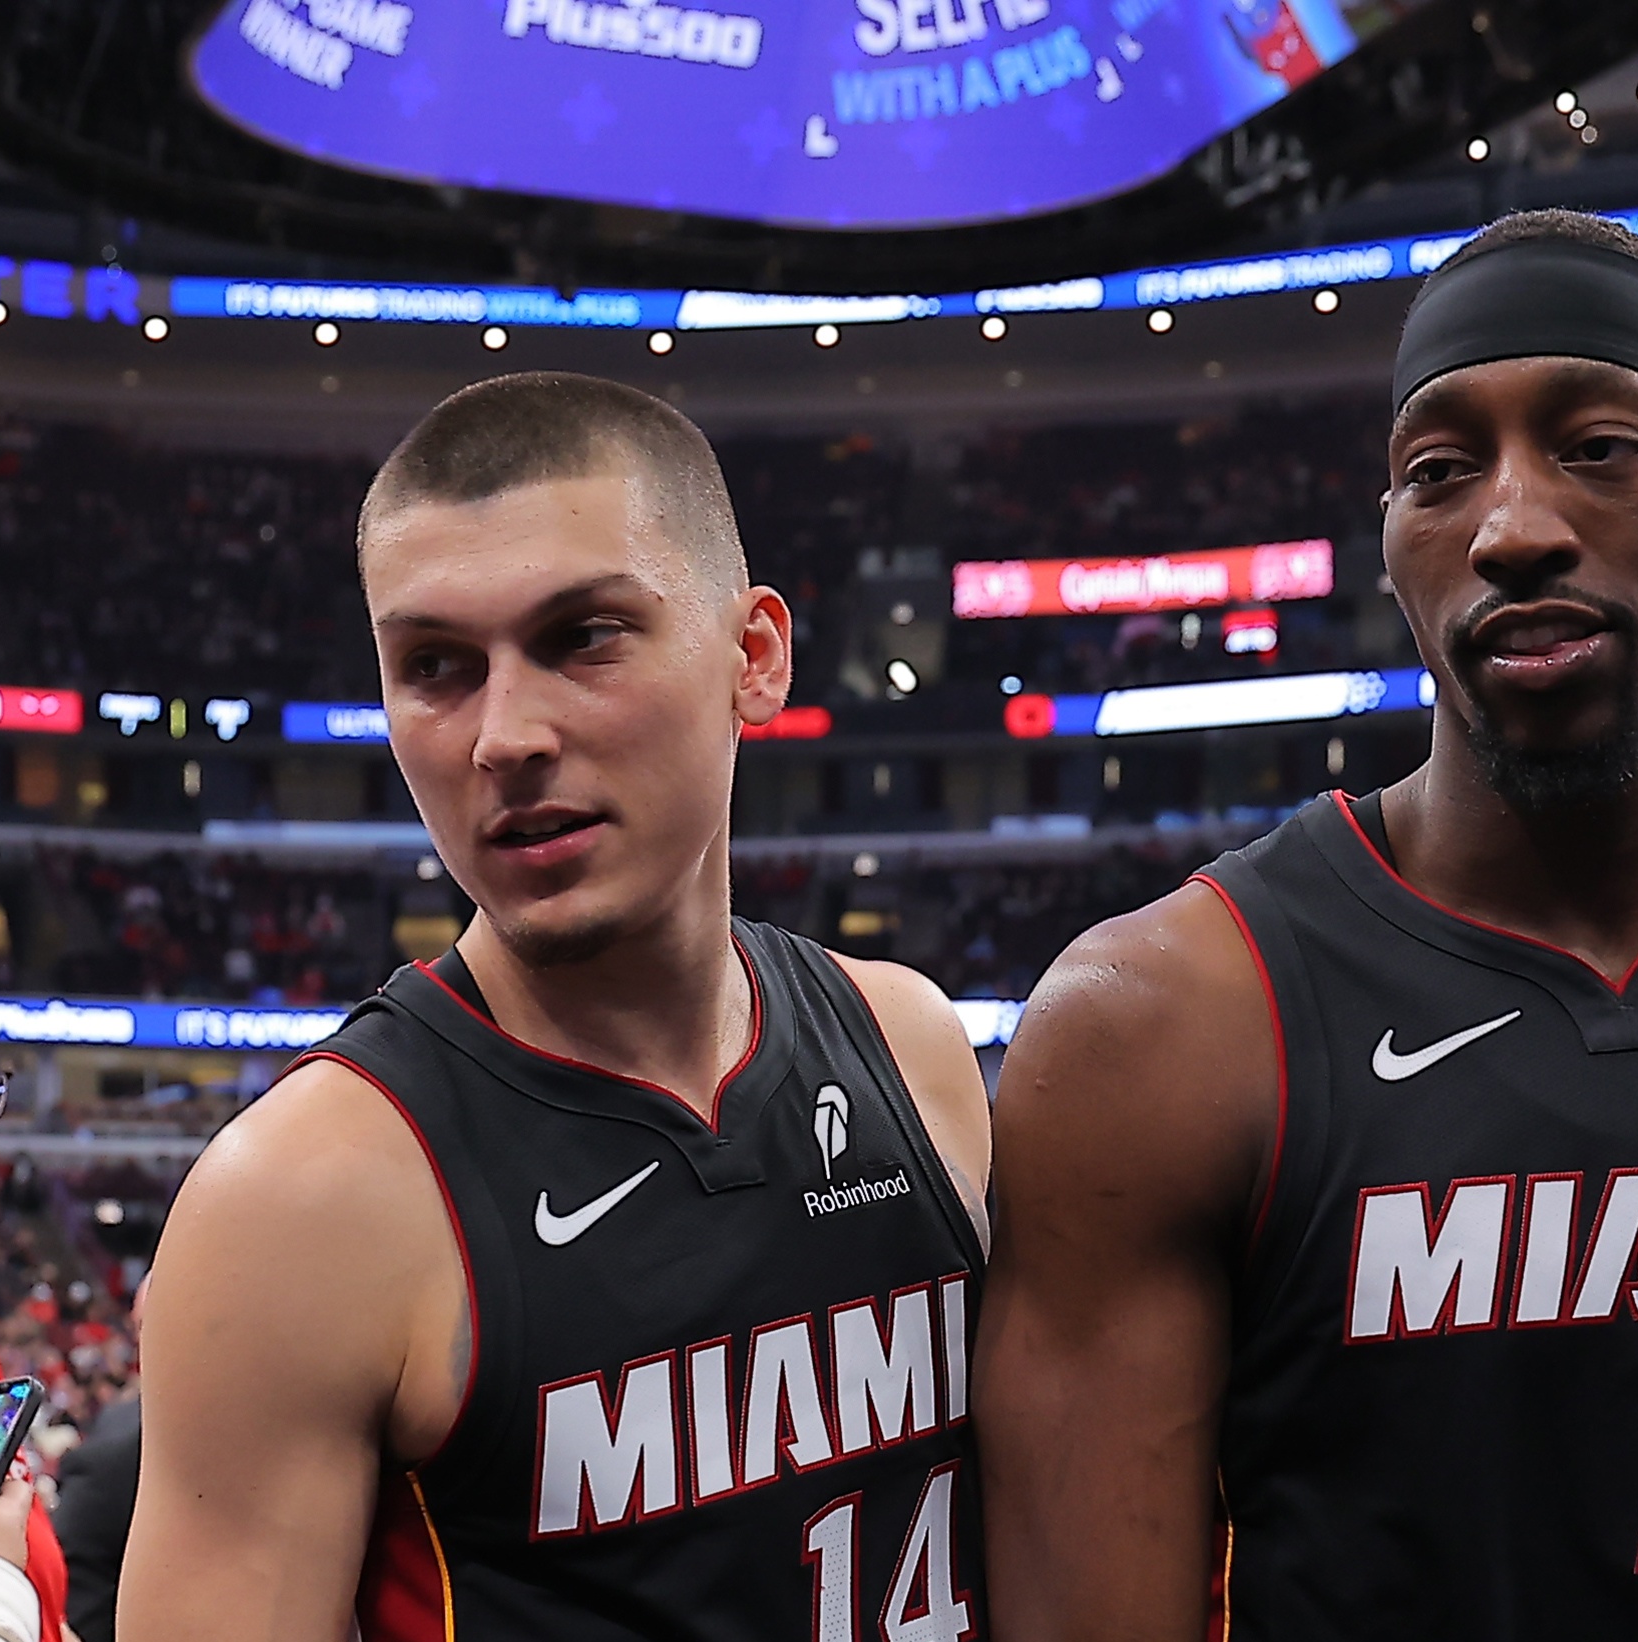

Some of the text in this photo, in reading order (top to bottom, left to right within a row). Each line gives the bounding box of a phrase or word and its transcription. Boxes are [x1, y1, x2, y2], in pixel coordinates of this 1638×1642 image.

[833, 25, 1091, 124] WITH A PLUS
[803, 1170, 911, 1219] Robinhood
[529, 1269, 970, 1543] MIAMI
